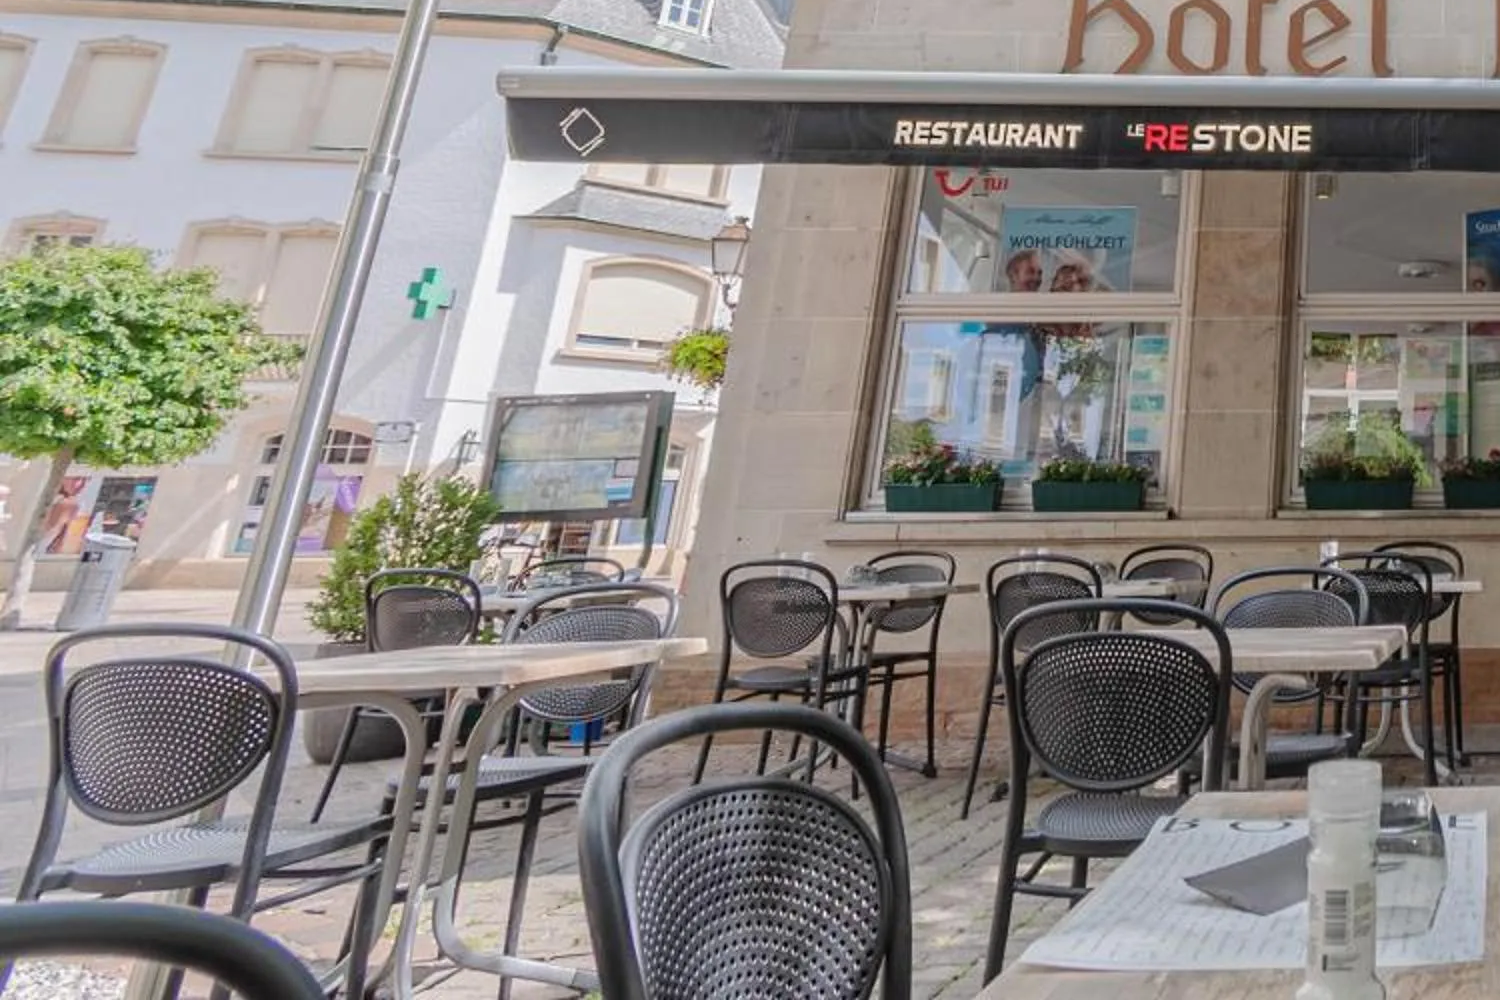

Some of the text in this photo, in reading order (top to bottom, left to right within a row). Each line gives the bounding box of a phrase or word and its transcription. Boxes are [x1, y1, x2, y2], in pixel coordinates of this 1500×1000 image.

[893, 119, 1083, 150] RESTAURANT
[1127, 123, 1144, 137] LE
[983, 177, 1009, 191] TUI
[1009, 233, 1126, 250] WOHLFÜHLZEIT
